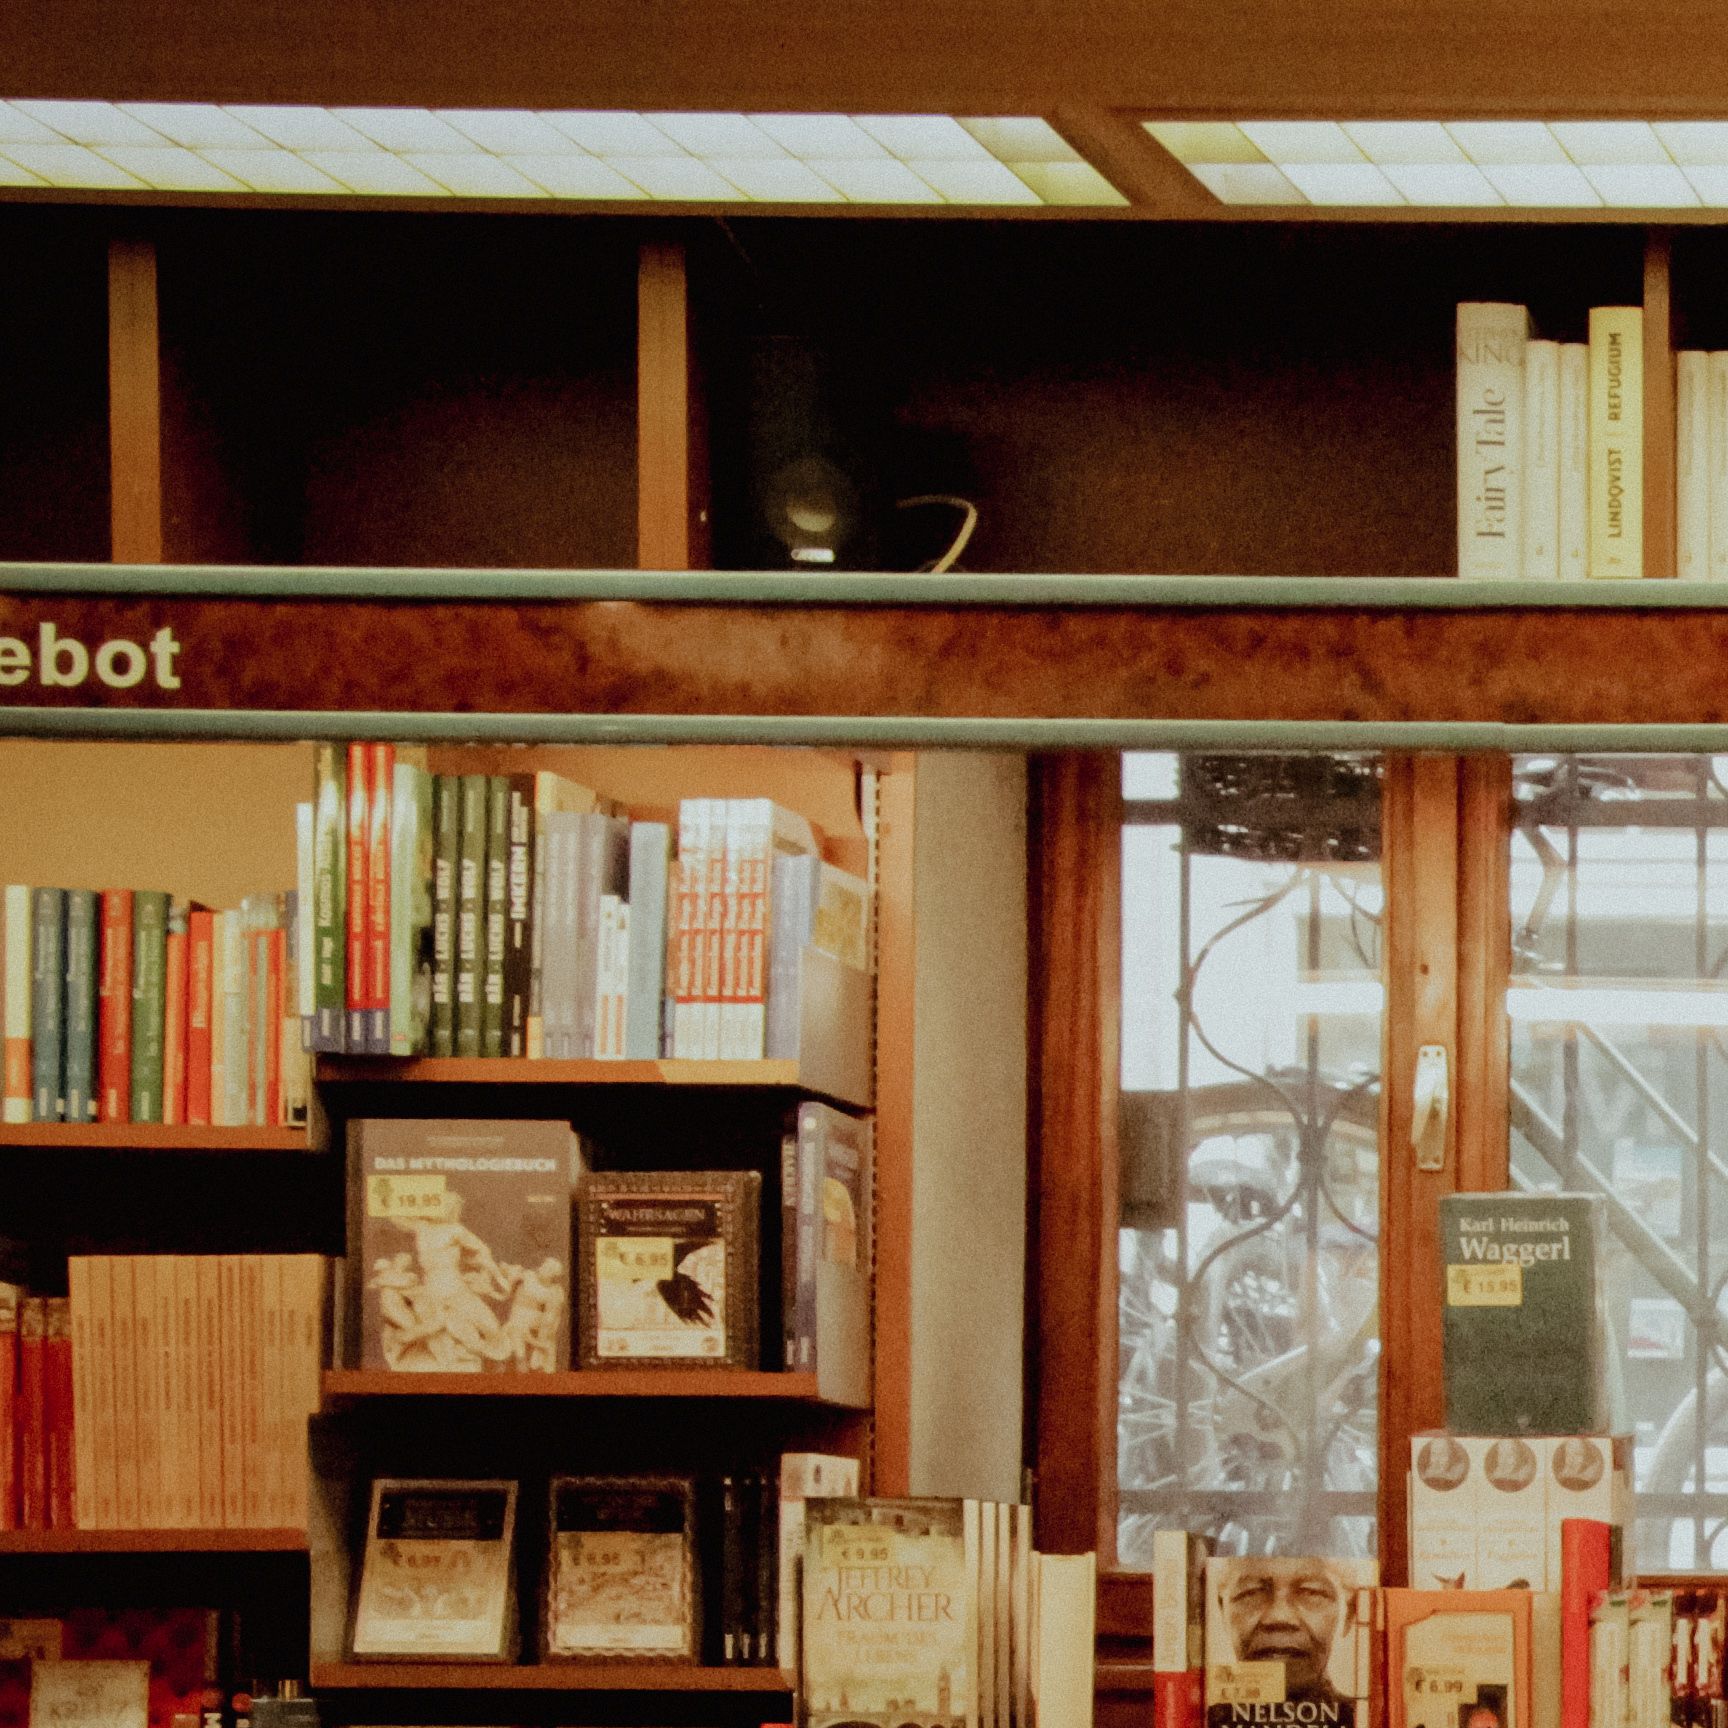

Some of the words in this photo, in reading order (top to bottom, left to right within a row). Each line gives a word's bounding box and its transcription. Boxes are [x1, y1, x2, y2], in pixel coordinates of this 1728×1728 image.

[1606, 332, 1623, 421] REFUGIUM
[1472, 387, 1507, 456] Tale
[1476, 463, 1514, 540] Fairy
[1606, 448, 1625, 538] LINDQVIST
[1459, 1217, 1494, 1232] Karl
[1500, 1217, 1570, 1232] Heinrich
[1459, 1236, 1571, 1266] Waggerl
[855, 1548, 889, 1561] 9.95
[834, 1566, 936, 1588] JEFFREY
[816, 1589, 953, 1621] ARCHER
[1231, 1701, 1340, 1723] NELSON
